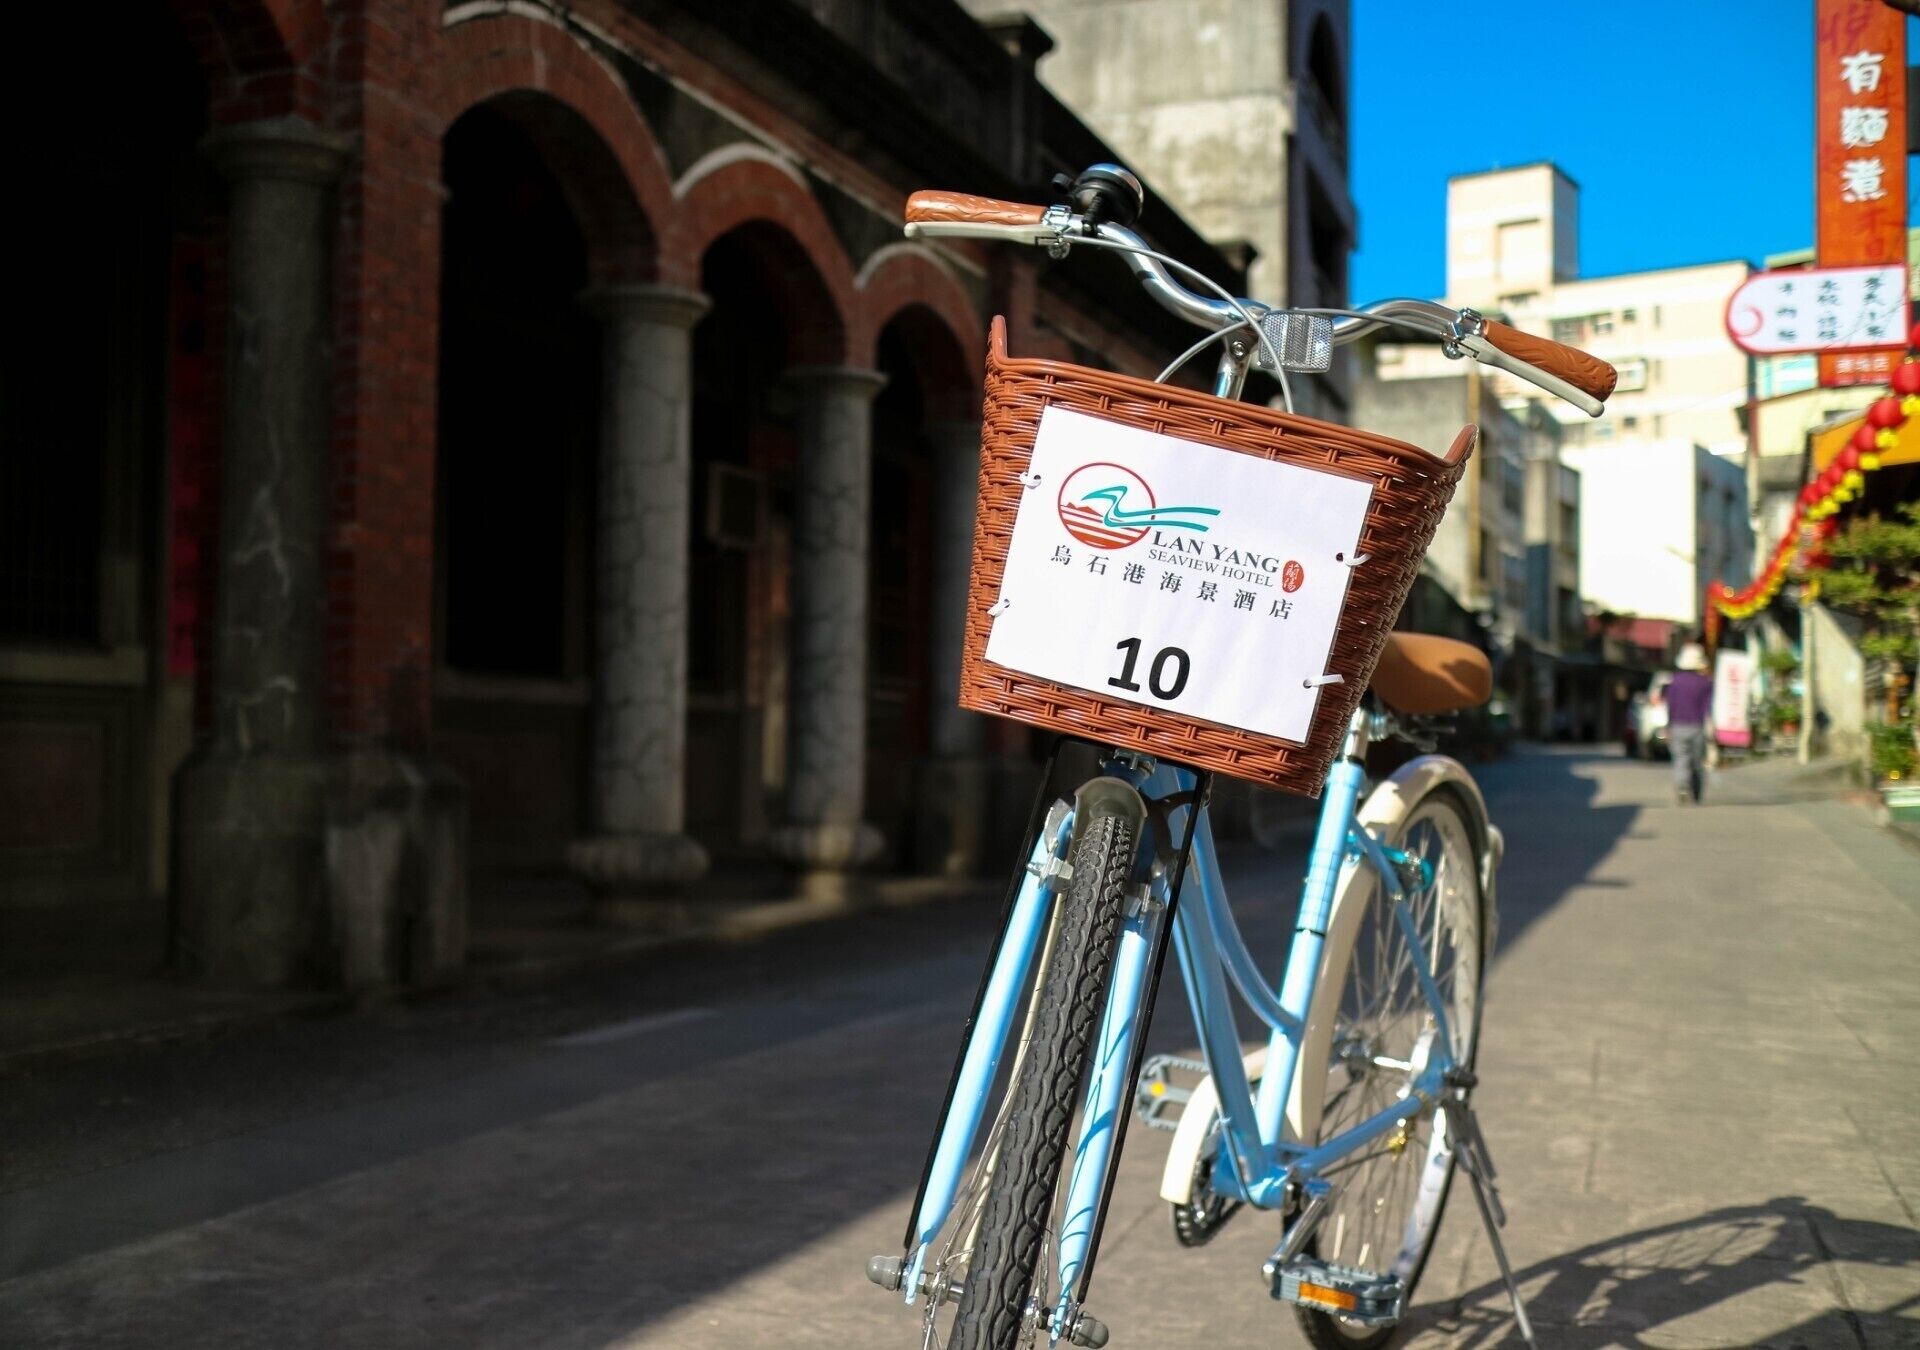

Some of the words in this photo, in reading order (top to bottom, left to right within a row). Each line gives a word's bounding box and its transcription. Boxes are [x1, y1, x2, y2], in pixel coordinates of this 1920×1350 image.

[1840, 50, 1889, 202] 有麵煮
[1050, 544, 1293, 620] 烏石港海景酒店
[1148, 548, 1218, 574] SEAVIEW
[1222, 566, 1274, 588] HOTEL
[1152, 530, 1204, 556] LAN
[1212, 544, 1280, 574] YANG
[1108, 637, 1190, 701] 10
